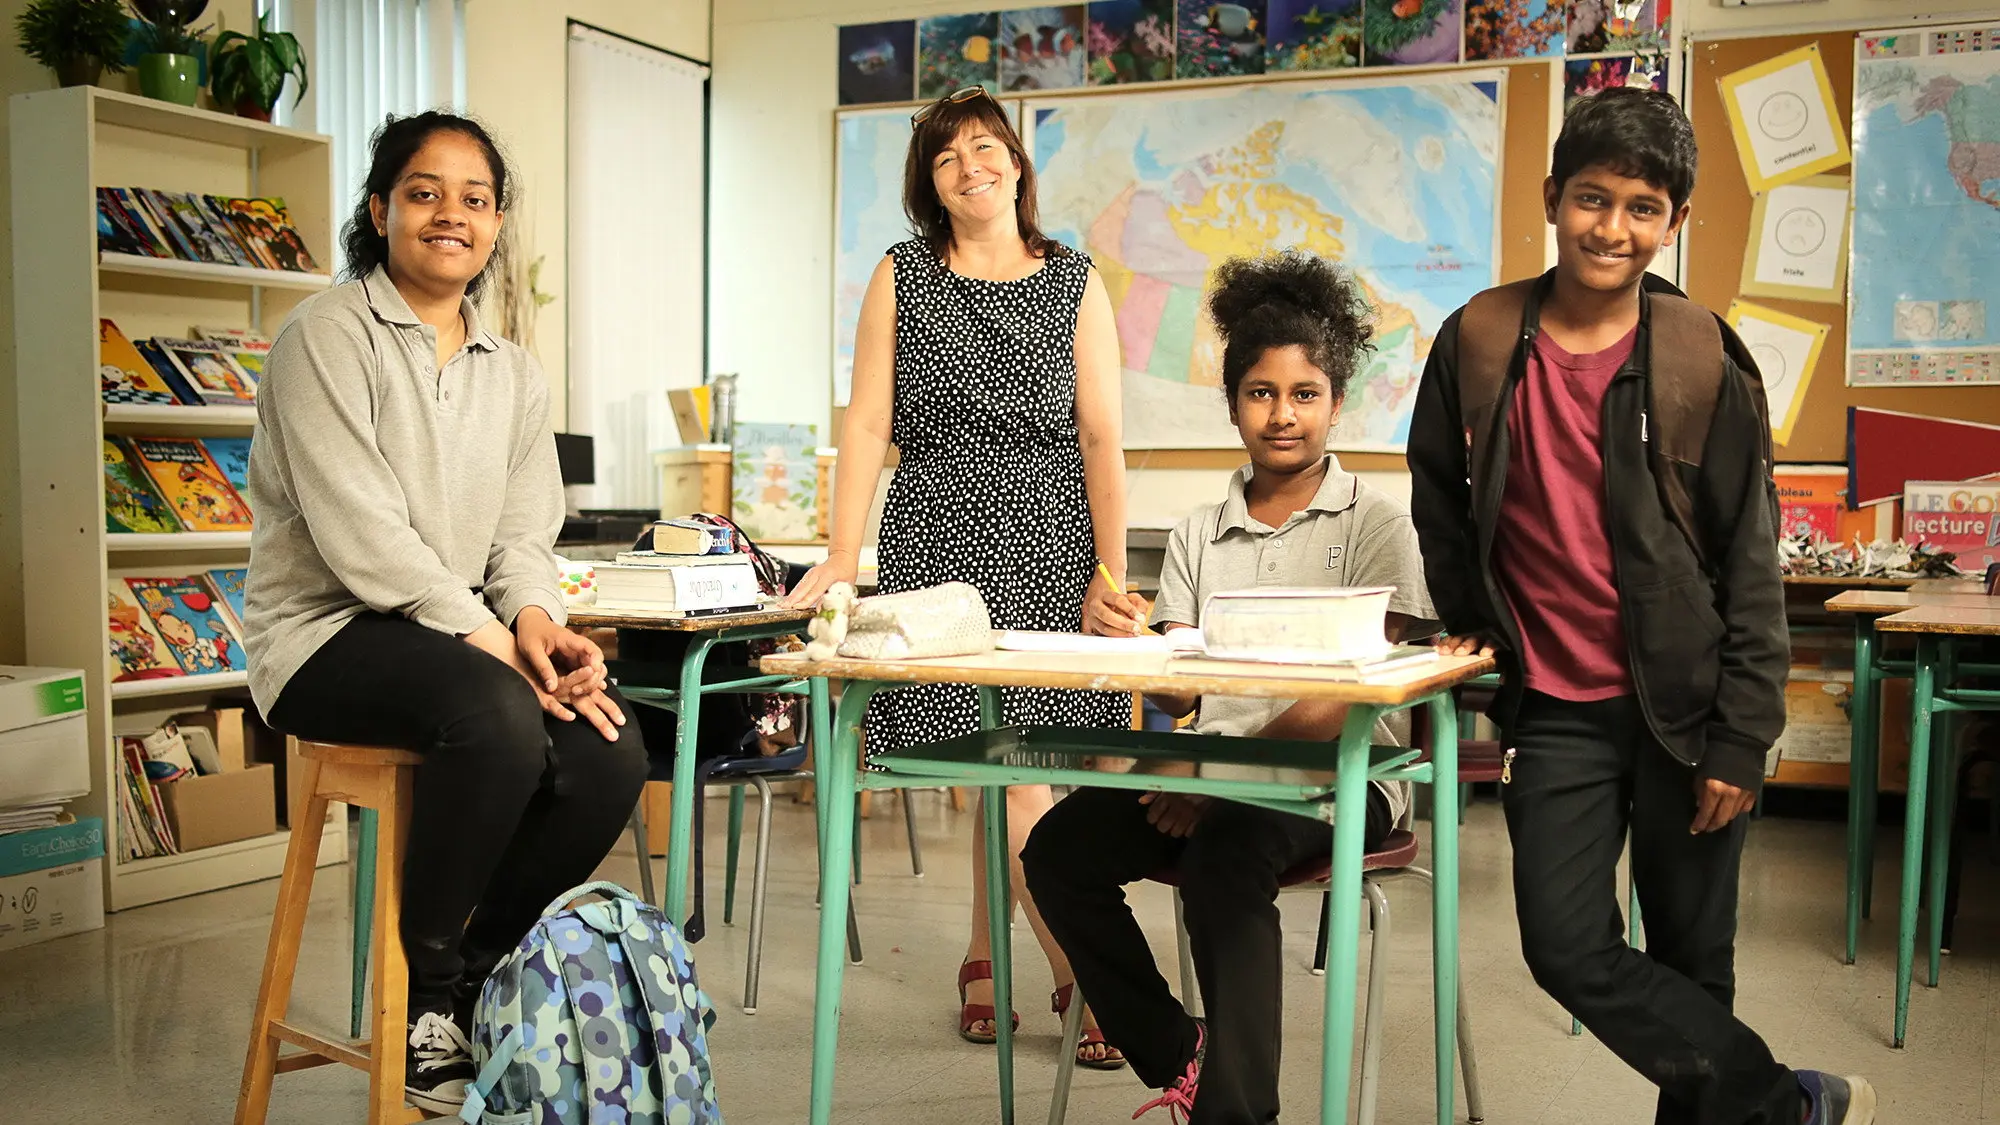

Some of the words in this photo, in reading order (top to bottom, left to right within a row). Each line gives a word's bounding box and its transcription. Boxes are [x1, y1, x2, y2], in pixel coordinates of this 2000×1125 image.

[1774, 143, 1817, 165] content(e)
[1776, 487, 1813, 498] ableau
[1909, 493, 1944, 512] LE
[1908, 515, 1986, 535] lecture
[1324, 545, 1344, 570] P
